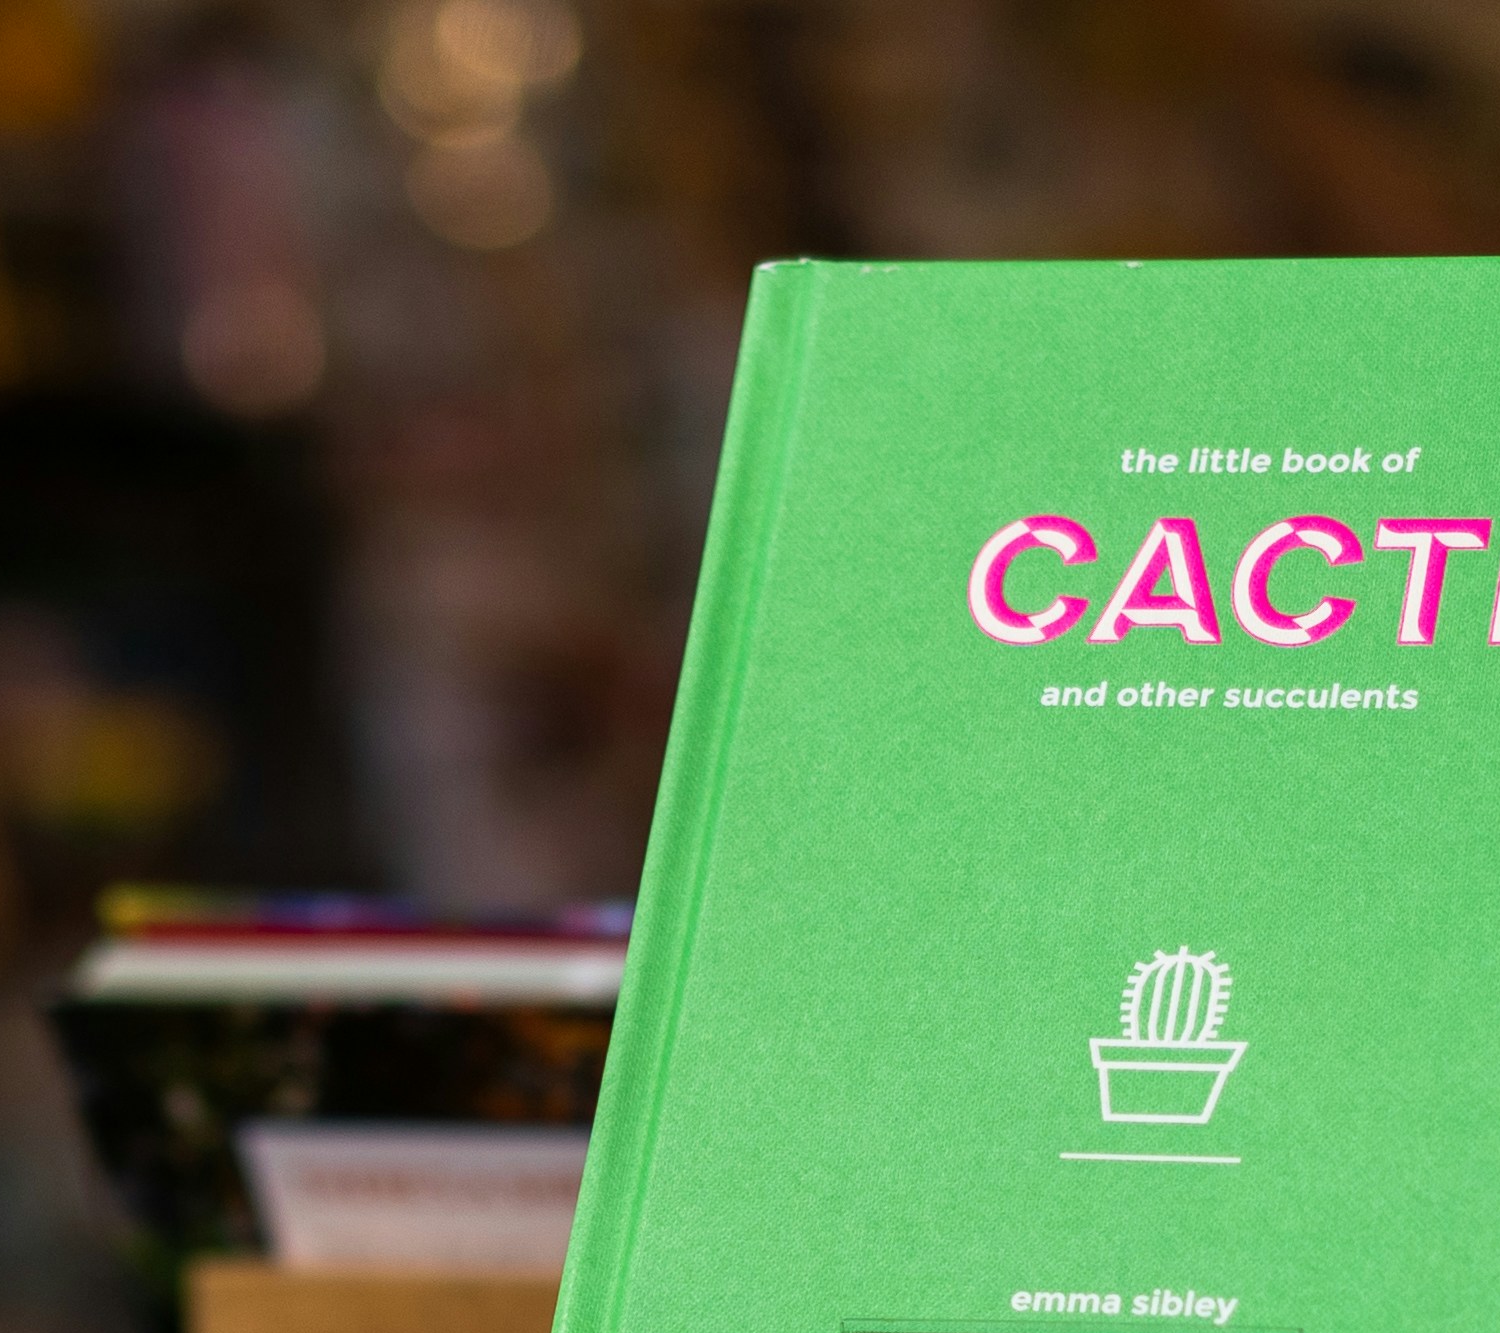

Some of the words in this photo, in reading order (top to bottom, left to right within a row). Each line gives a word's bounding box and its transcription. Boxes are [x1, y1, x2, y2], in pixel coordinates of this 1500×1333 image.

[1119, 447, 1179, 476] the
[1188, 447, 1273, 476] little
[1281, 447, 1372, 476] book
[1381, 447, 1422, 476] of
[1040, 680, 1108, 709] and
[1116, 681, 1214, 710] other
[1222, 681, 1420, 712] succulents
[1009, 1289, 1123, 1318] emma
[1131, 1287, 1239, 1325] sibley
